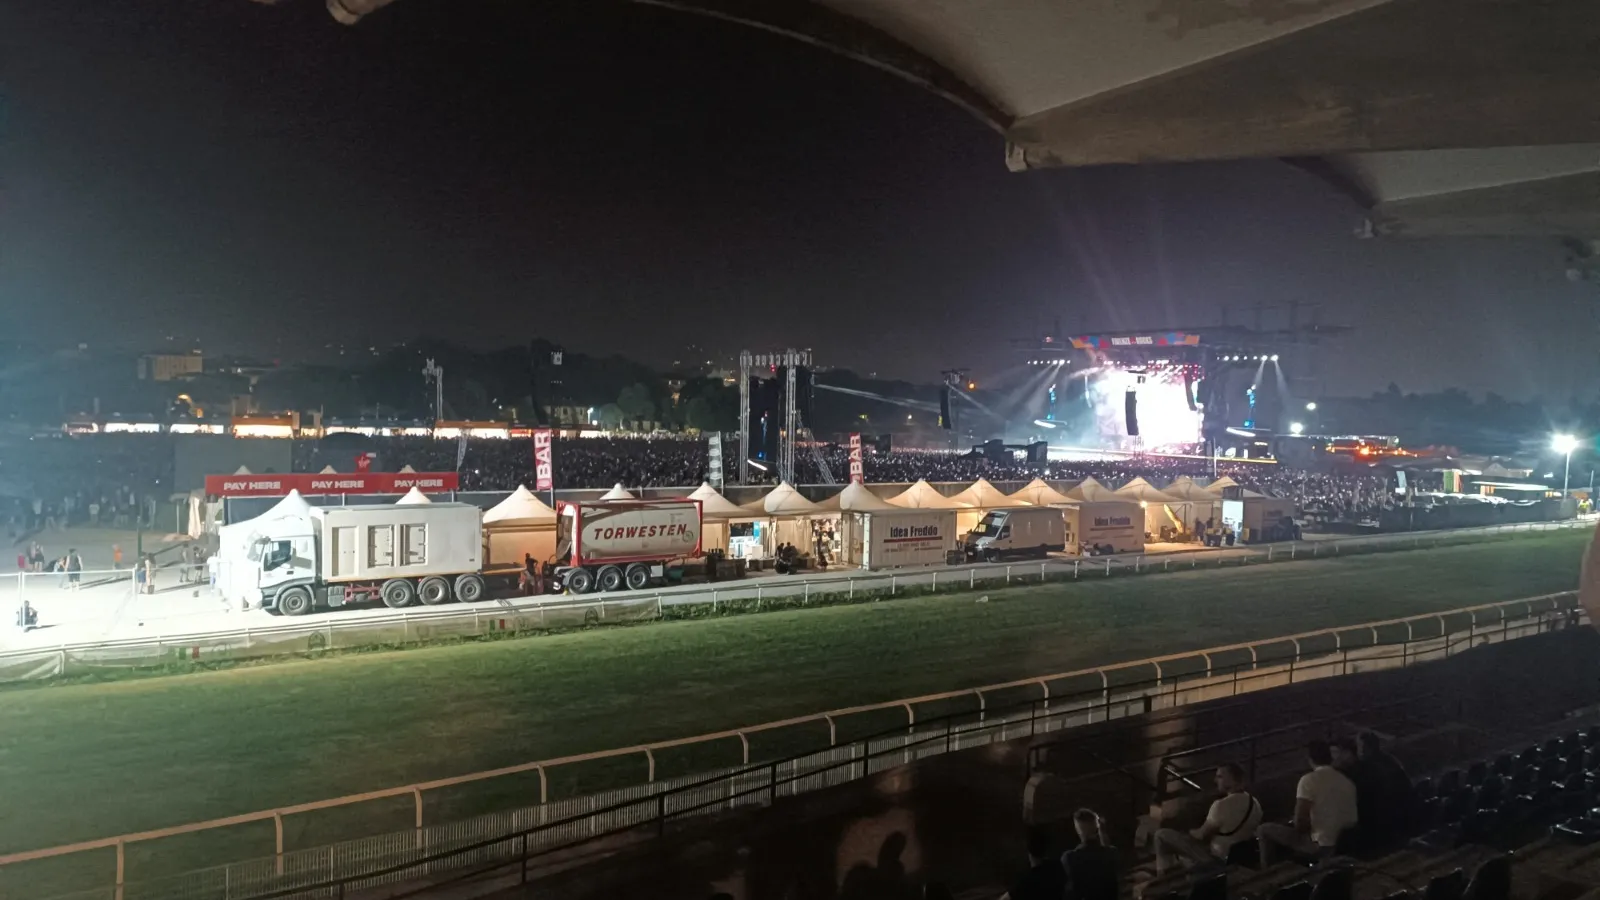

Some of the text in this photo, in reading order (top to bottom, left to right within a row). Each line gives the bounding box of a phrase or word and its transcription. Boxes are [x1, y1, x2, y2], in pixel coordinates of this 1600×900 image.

[535, 432, 551, 478] BAR
[850, 435, 861, 475] BAR
[223, 481, 281, 491] PAY HERE
[594, 524, 687, 540] TORWESTEN
[890, 526, 938, 538] Idea Freddo
